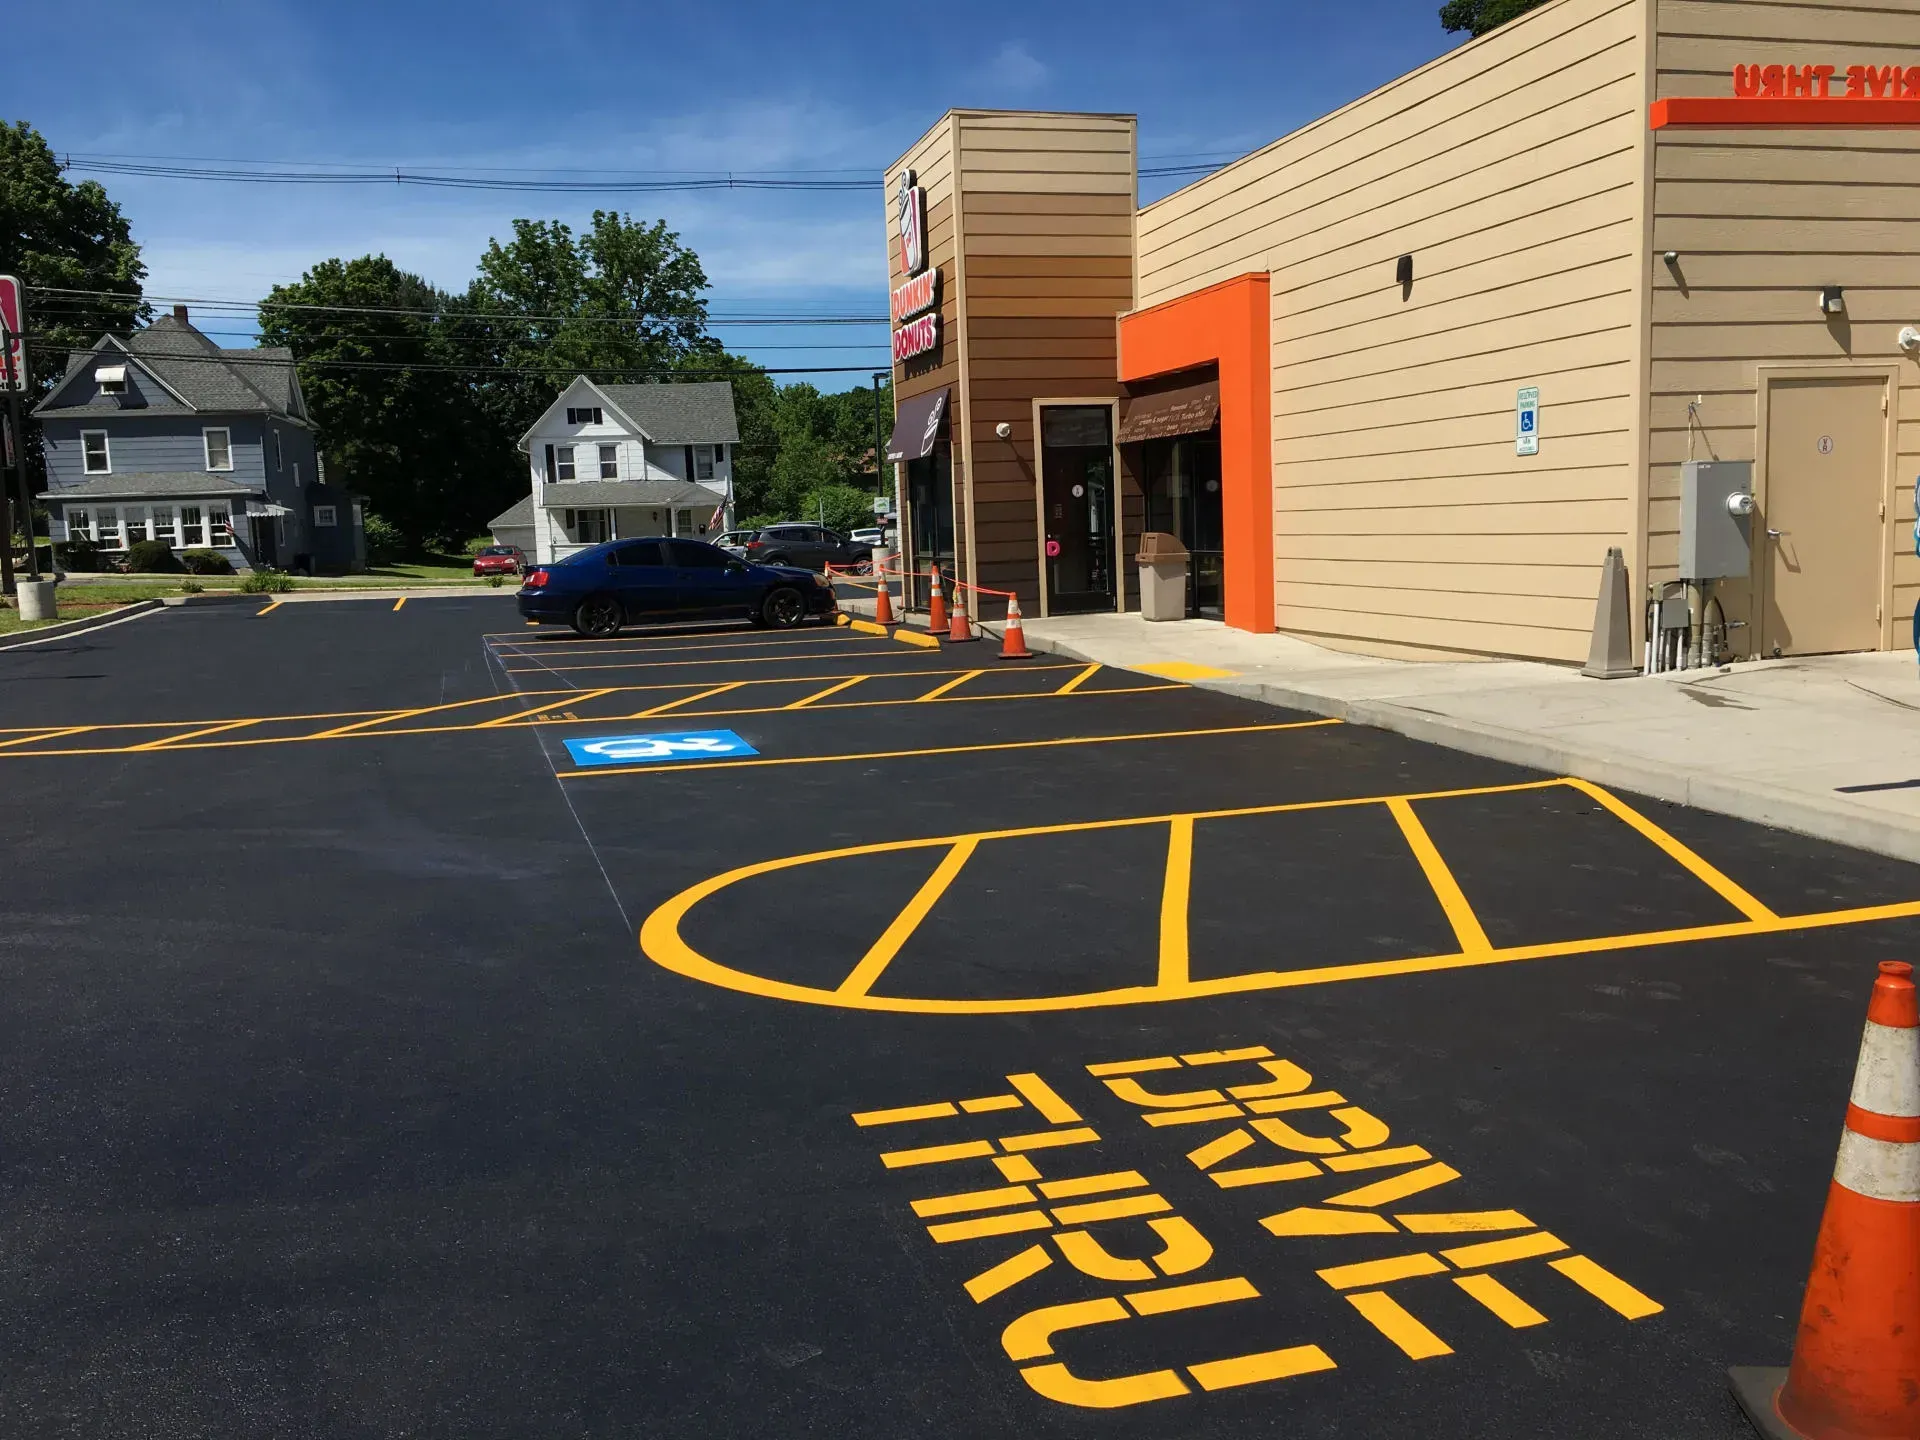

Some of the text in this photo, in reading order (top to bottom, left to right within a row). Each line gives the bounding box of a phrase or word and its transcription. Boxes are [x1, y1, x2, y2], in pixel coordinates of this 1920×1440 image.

[893, 269, 935, 321] DUNKIN'
[894, 314, 935, 361] DONUTS
[851, 1072, 1338, 1409] THRU
[1086, 1046, 1665, 1360] DRIVE
